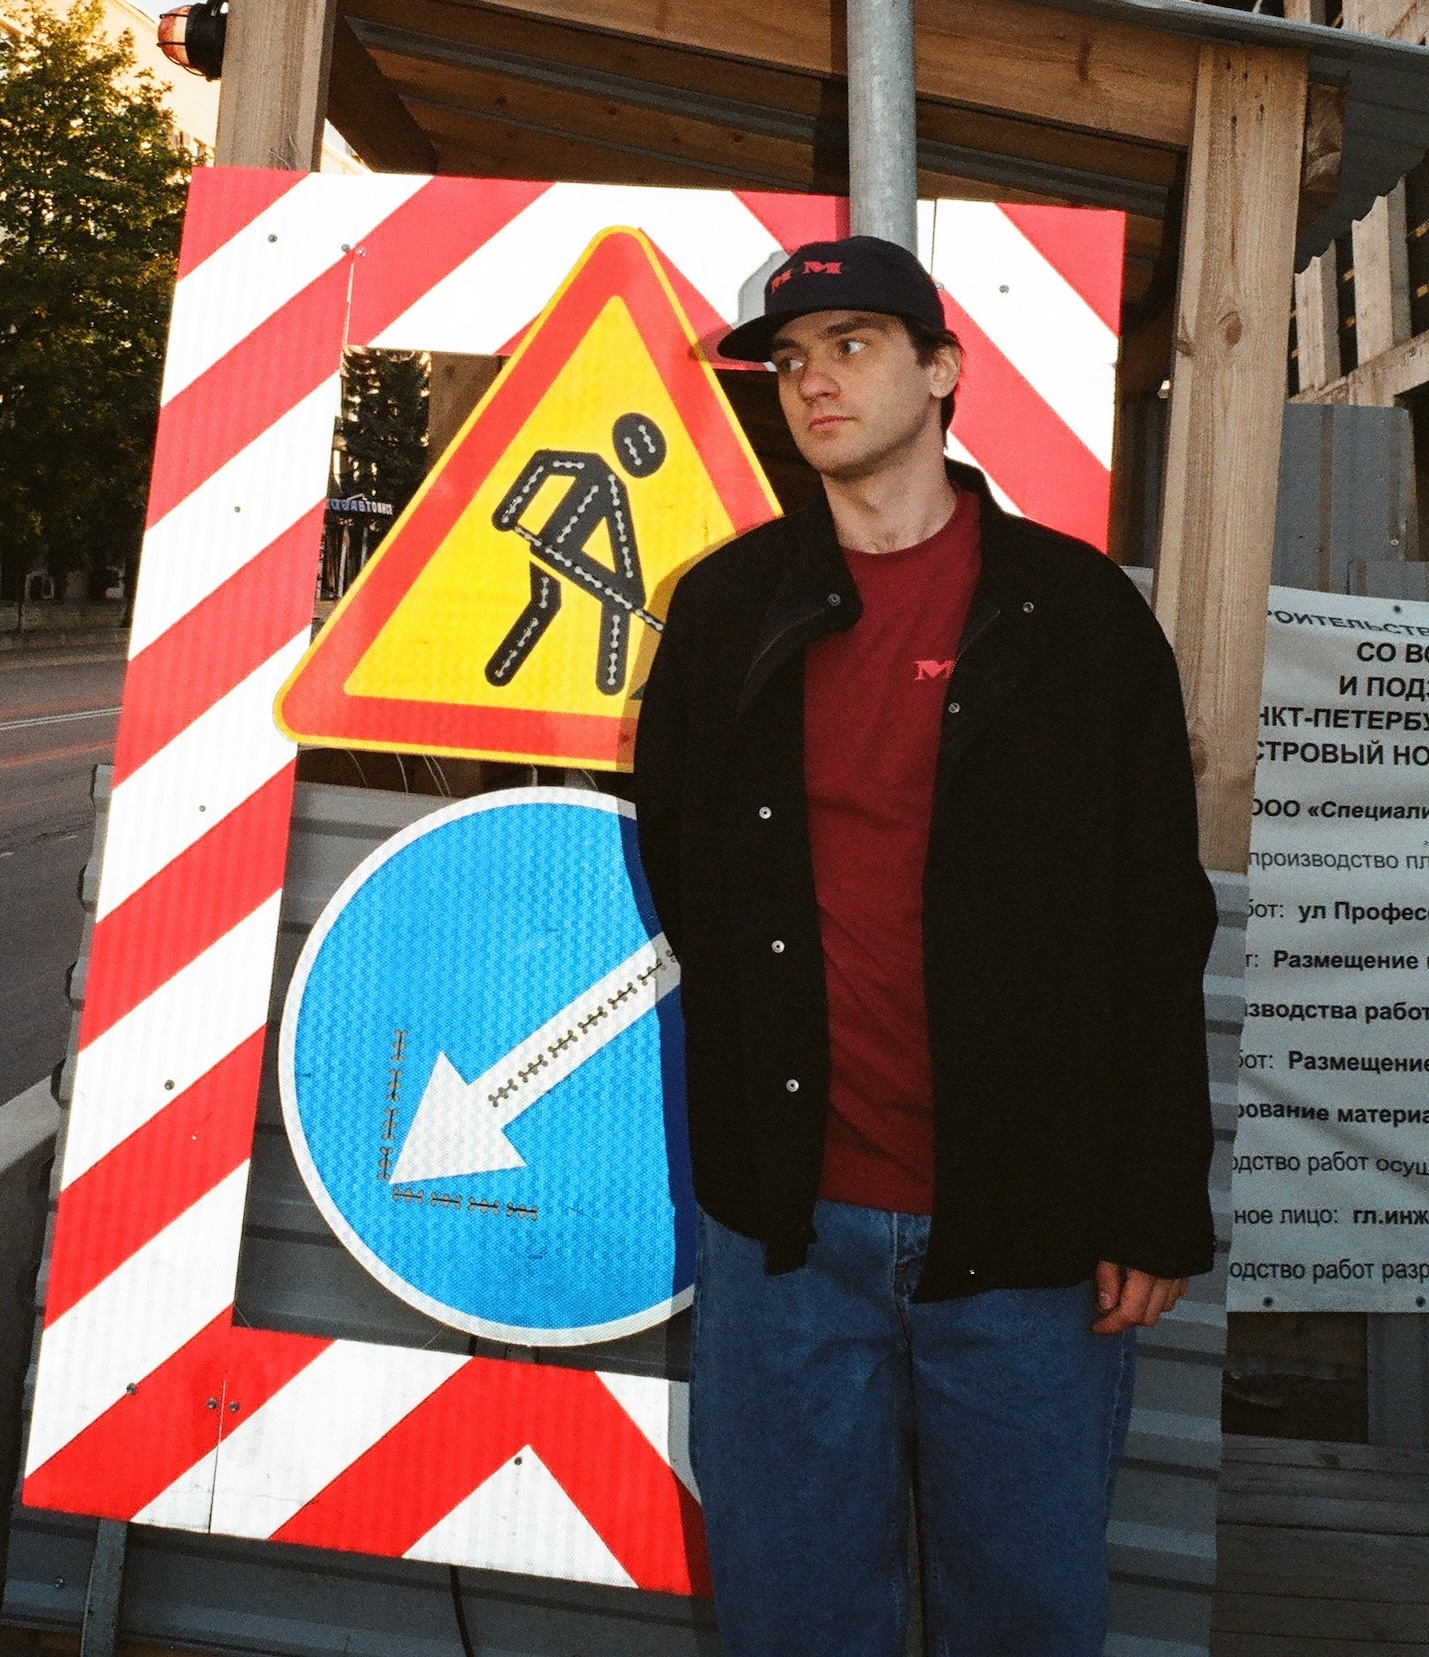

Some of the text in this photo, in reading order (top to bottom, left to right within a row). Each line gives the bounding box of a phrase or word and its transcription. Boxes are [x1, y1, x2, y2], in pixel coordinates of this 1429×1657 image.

[1267, 610, 1429, 637] ОИТЕЛЬСТВ
[1357, 641, 1429, 663] СО В
[1339, 675, 1429, 702] И ПОД
[1393, 744, 1429, 767] НО
[1249, 852, 1399, 870] производство
[1298, 904, 1327, 923] ул
[1334, 901, 1429, 924] Профес
[1273, 950, 1418, 971] Размещение
[1244, 1002, 1357, 1021] зводства
[1308, 1151, 1369, 1175] работ
[1280, 1208, 1338, 1226] лицо:
[1230, 1259, 1429, 1284] одство работ разр
